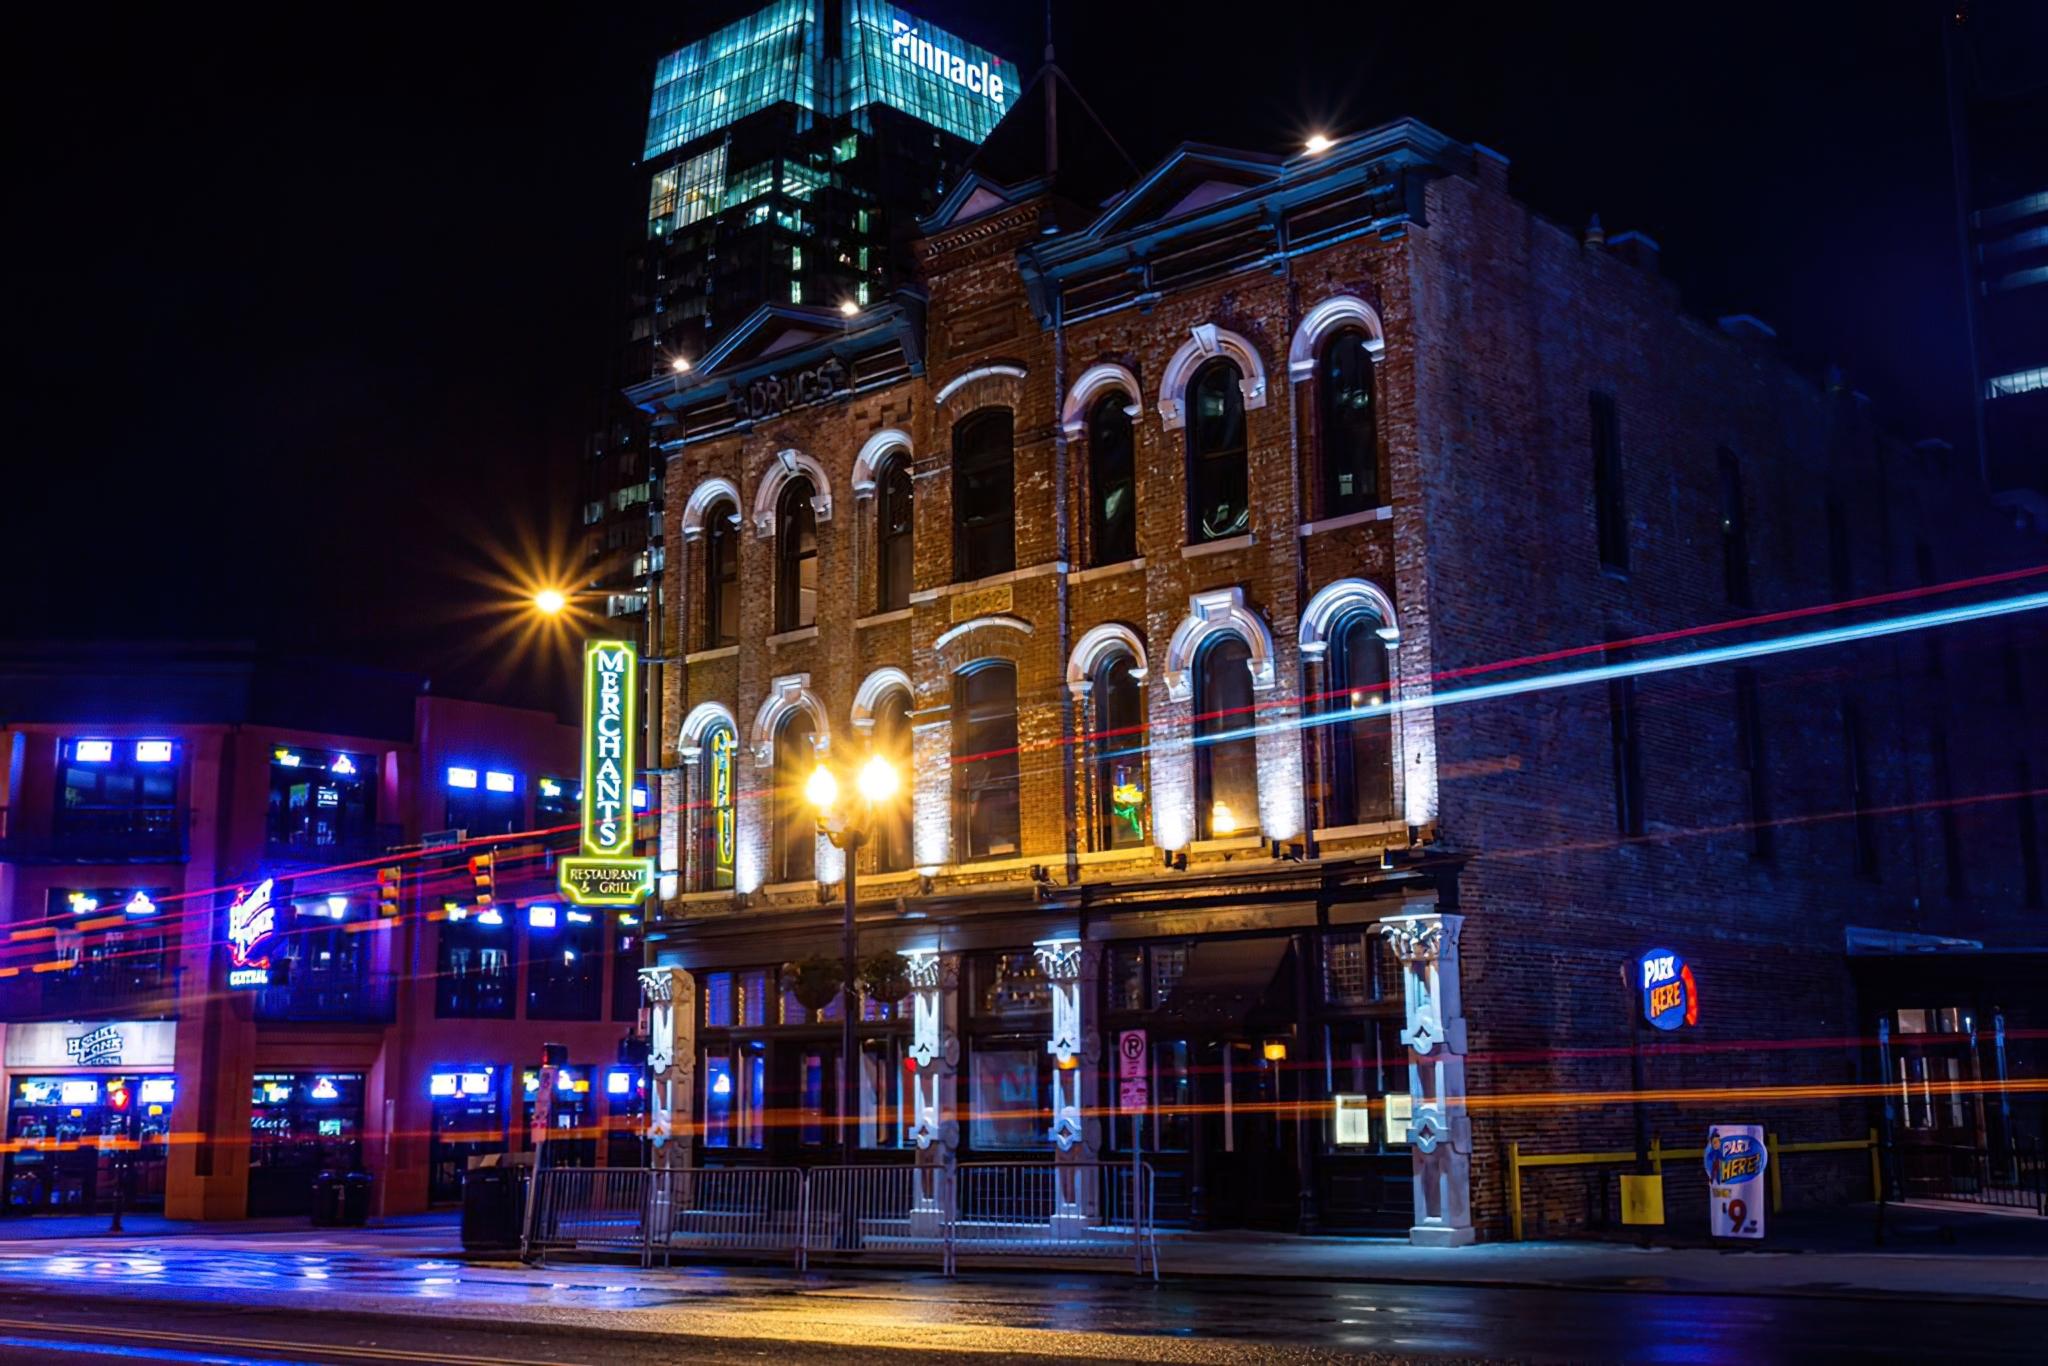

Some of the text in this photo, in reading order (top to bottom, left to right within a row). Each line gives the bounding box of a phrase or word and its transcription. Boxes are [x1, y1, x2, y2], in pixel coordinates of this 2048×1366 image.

[893, 19, 1004, 104] Pinnacle
[750, 358, 842, 417] DRUGS
[597, 650, 624, 846] MERCHANTS
[570, 868, 644, 881] RESTAURANT
[599, 881, 635, 894] GRILL
[1644, 956, 1675, 989] PARK
[1651, 981, 1681, 1018] HERE
